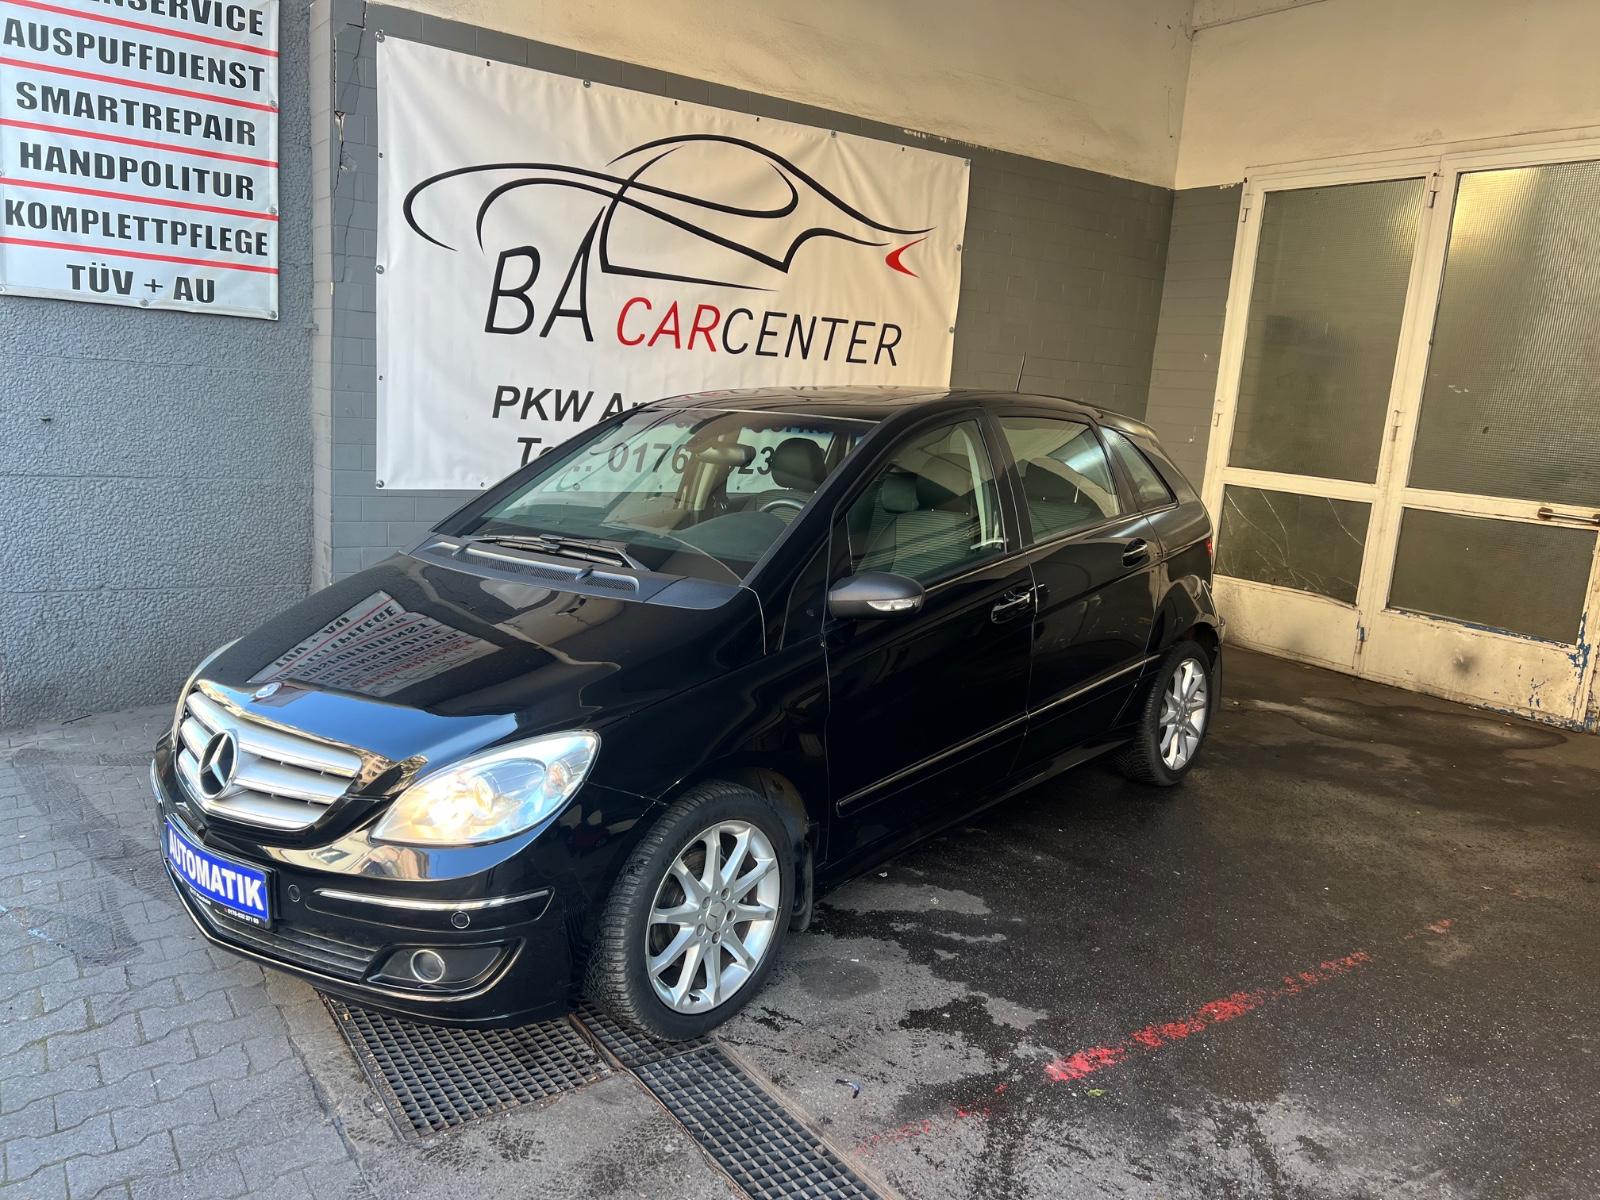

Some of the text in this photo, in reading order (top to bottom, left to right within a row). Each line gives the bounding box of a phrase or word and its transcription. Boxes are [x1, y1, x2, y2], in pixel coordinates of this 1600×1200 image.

[3, 17, 266, 92] AUSPUFFDIENST
[16, 81, 256, 147] SMARTREPAIR
[20, 141, 254, 201] HANDPOLITUR
[5, 198, 268, 257] KOMPLETTPFLEGE
[66, 261, 215, 304] TÜV + AU
[484, 206, 903, 367] BA CARCENTER
[492, 385, 595, 423] PKW
[169, 828, 265, 911] AUTOMATIK
